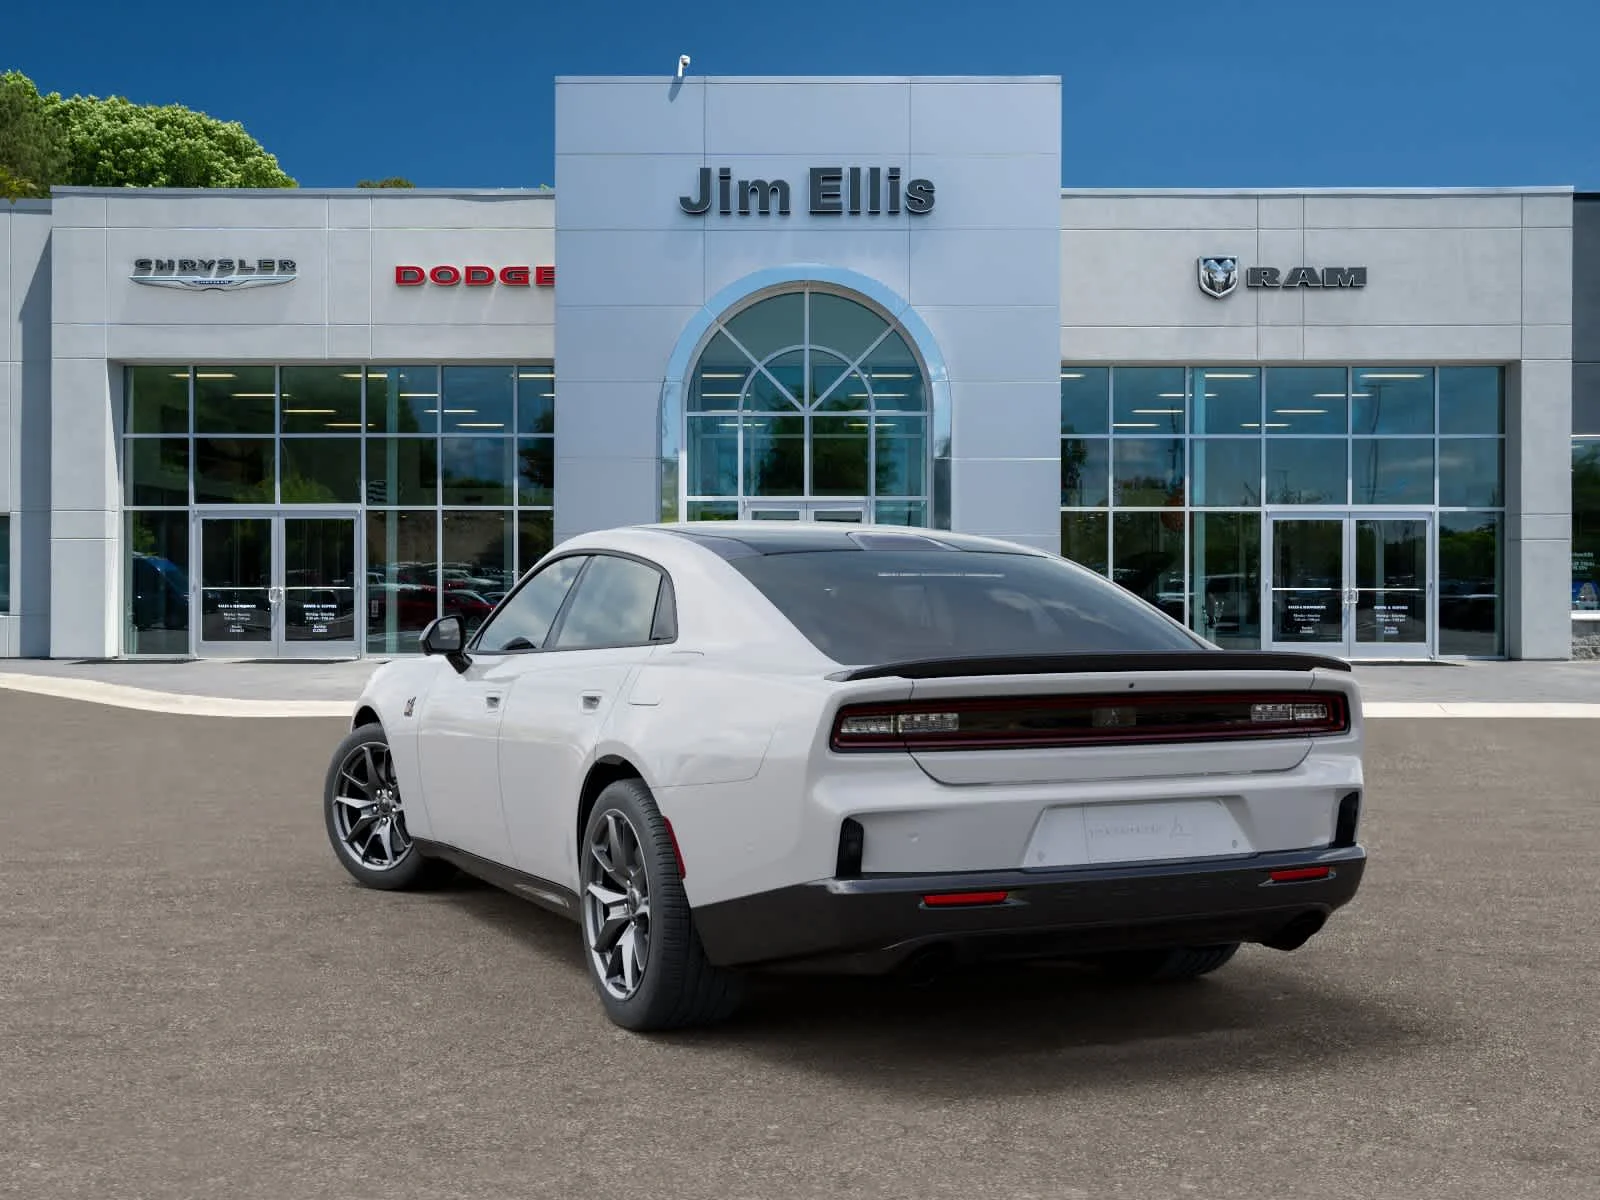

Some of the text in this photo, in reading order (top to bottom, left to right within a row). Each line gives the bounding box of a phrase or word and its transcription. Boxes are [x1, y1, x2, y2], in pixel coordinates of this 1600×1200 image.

[679, 167, 936, 213] Jim Ellis
[134, 258, 297, 272] CHRYSLER
[395, 265, 555, 287] DODGE
[1247, 267, 1368, 287] RAM
